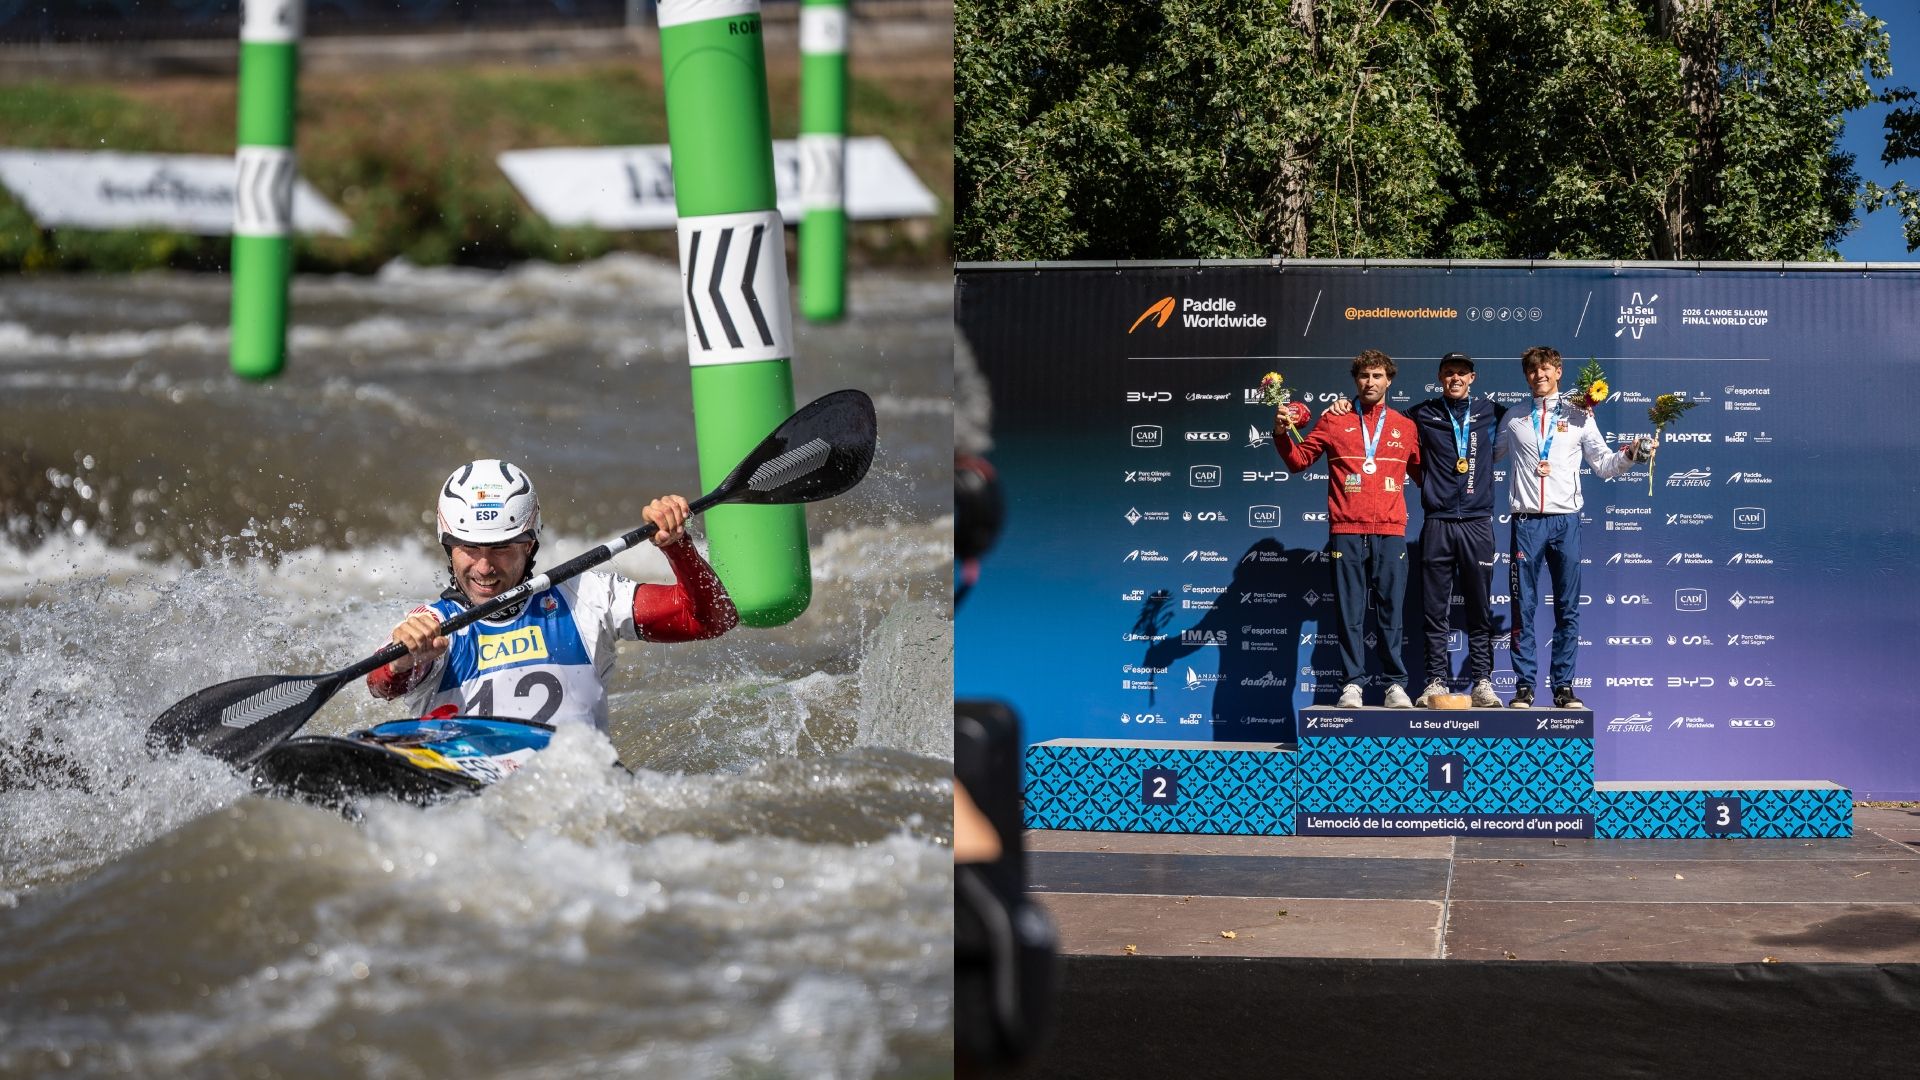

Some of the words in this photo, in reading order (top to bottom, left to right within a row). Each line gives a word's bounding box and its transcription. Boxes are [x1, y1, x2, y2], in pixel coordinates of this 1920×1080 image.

[1183, 298, 1236, 312] Paddle
[1345, 307, 1458, 320] @paddleworldwide
[1620, 306, 1633, 315] La
[1635, 306, 1654, 315] Seu
[1733, 309, 1768, 317] SLALOM
[1183, 314, 1267, 328] Worldwide
[1617, 315, 1657, 326] d'Urgell
[1682, 317, 1711, 325] FINAL
[1712, 317, 1747, 325] WORLD
[1748, 317, 1768, 326] CUP
[1126, 392, 1172, 402] BYD
[1734, 388, 1770, 396] esportcat
[1136, 430, 1157, 440] CADÍ
[1725, 435, 1745, 443] lleida
[1195, 470, 1216, 480] CADÍ
[1242, 471, 1289, 481] BYD
[1467, 458, 1476, 489] BRITAIN
[1666, 479, 1680, 487] PEI
[1682, 479, 1711, 487] SHENG
[476, 511, 498, 520] ESP
[1254, 510, 1275, 520] CADÍ
[1615, 507, 1652, 515] esportcat
[1738, 513, 1760, 522] CADÍ
[1192, 586, 1228, 594] esportcat
[1680, 594, 1702, 603] CADÍ
[1181, 630, 1228, 641] IMAS
[1251, 627, 1288, 635] esportcat
[479, 629, 541, 662] CADÍ
[1132, 666, 1168, 674] esportcat
[1495, 675, 1517, 685] CADÍ
[1667, 676, 1714, 687] BYD
[465, 671, 563, 725] 12
[1409, 721, 1422, 729] La
[1423, 721, 1442, 729] Seu
[1443, 720, 1480, 731] d'Urgell
[1606, 724, 1621, 732] PEI
[1623, 724, 1653, 733] SHENG
[1440, 763, 1451, 784] 1
[1152, 777, 1167, 798] 2
[1716, 805, 1731, 826] 3
[1307, 817, 1360, 829] L'emoció
[1363, 818, 1379, 829] de
[1381, 818, 1393, 829] la
[1396, 817, 1468, 832] competició,
[1471, 818, 1482, 830] el
[1483, 818, 1524, 830] record
[1526, 818, 1553, 831] d'un
[1555, 818, 1583, 832] podi
